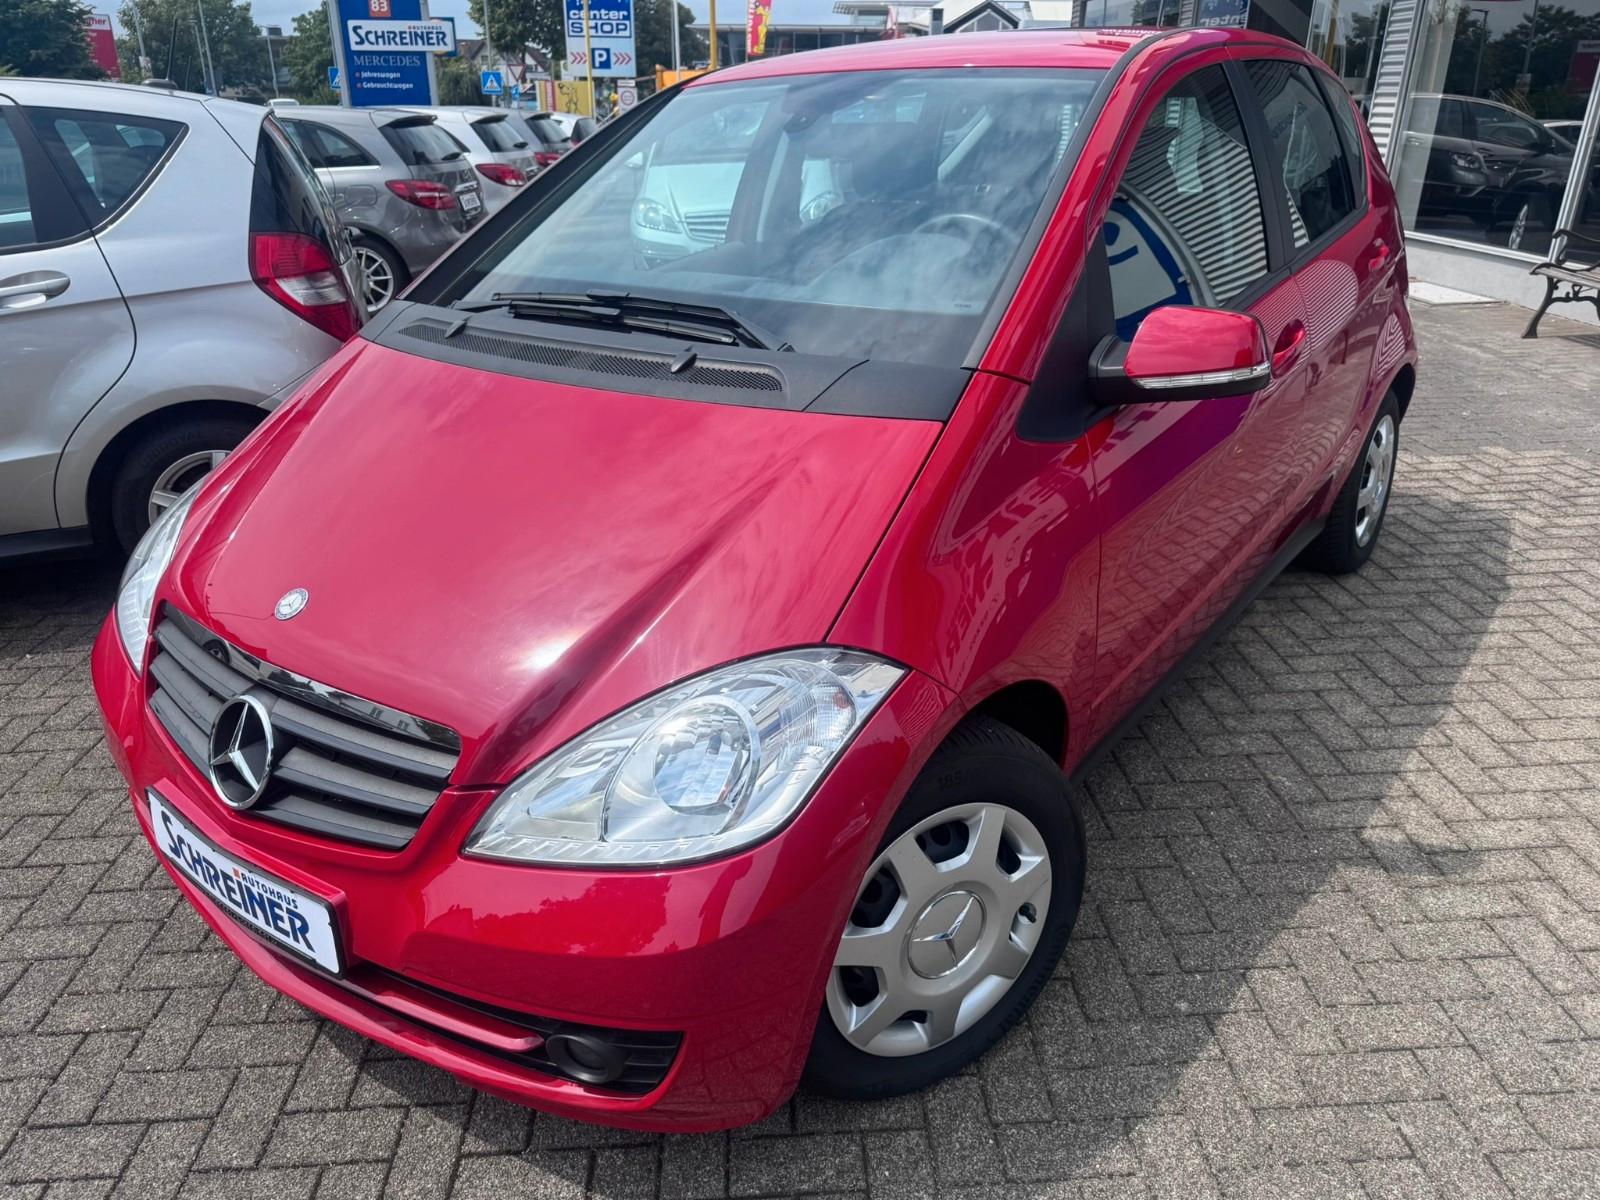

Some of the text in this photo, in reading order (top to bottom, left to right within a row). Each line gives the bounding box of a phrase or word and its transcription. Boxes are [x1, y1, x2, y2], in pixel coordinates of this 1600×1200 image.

[370, 0, 388, 12] 83
[352, 25, 448, 46] SCHREINER
[570, 22, 628, 34] SHOP
[353, 55, 421, 67] MERCEDES
[594, 47, 607, 67] P
[362, 81, 414, 91] Gebrauchtwagen
[161, 810, 316, 953] SCHREINER
[241, 872, 298, 910] AUTOHAUS
